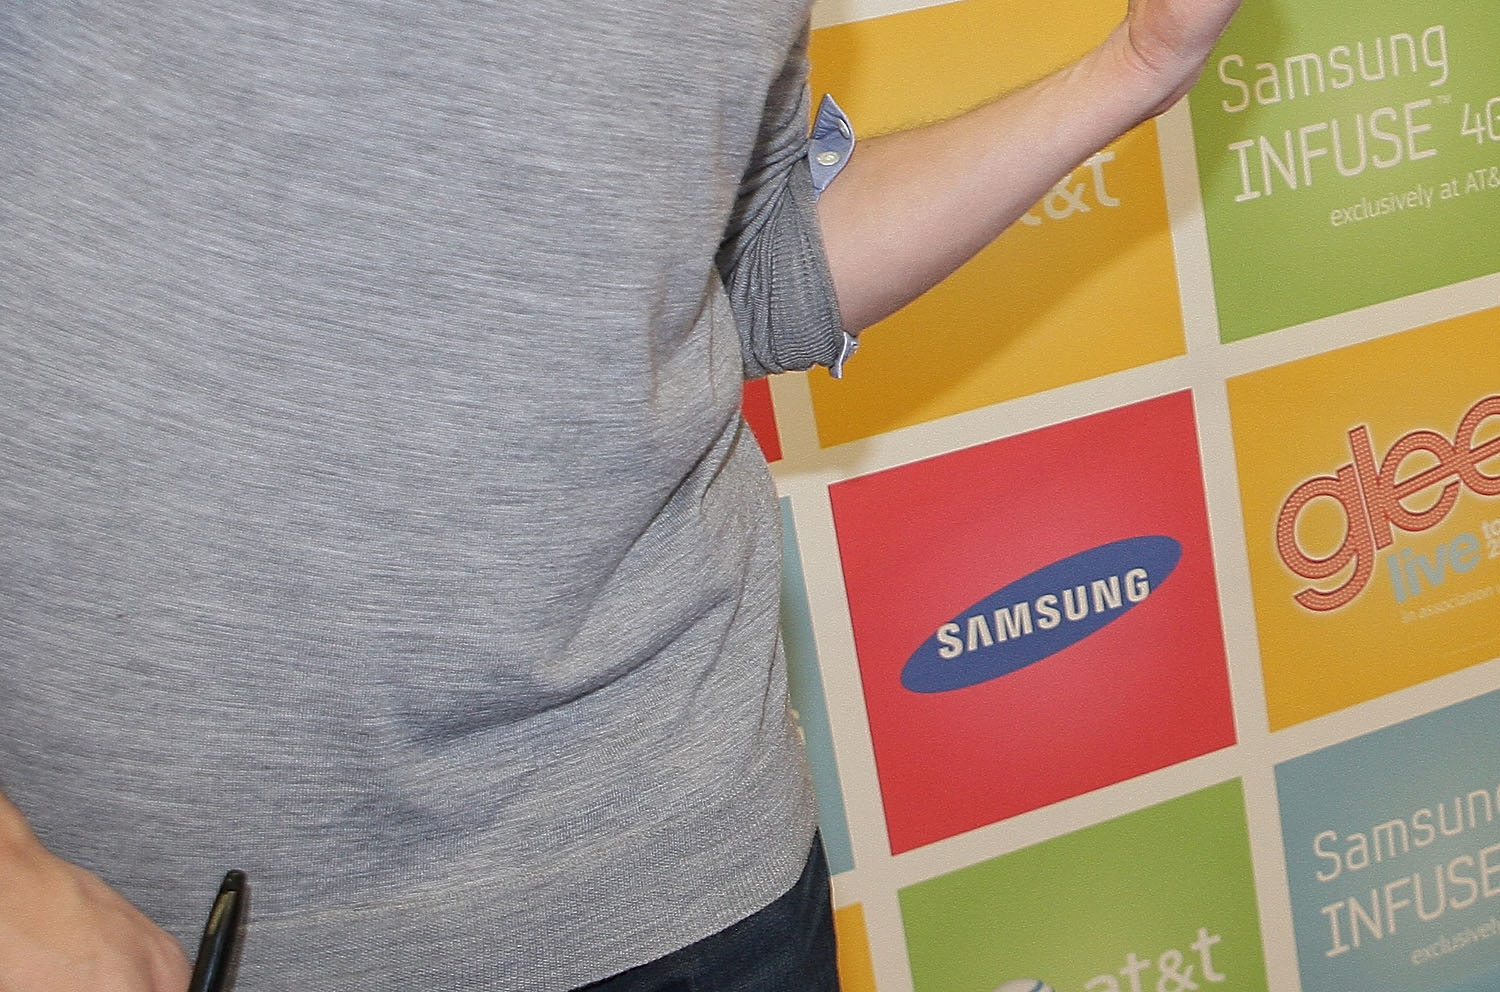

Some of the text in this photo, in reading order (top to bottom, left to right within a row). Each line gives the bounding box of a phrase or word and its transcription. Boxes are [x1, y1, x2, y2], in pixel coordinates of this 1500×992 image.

[1219, 25, 1450, 112] Samsung
[1330, 183, 1434, 227] exclusively
[1440, 176, 1461, 199] at
[1387, 532, 1481, 605] live
[936, 567, 1151, 660] SAMSUNG
